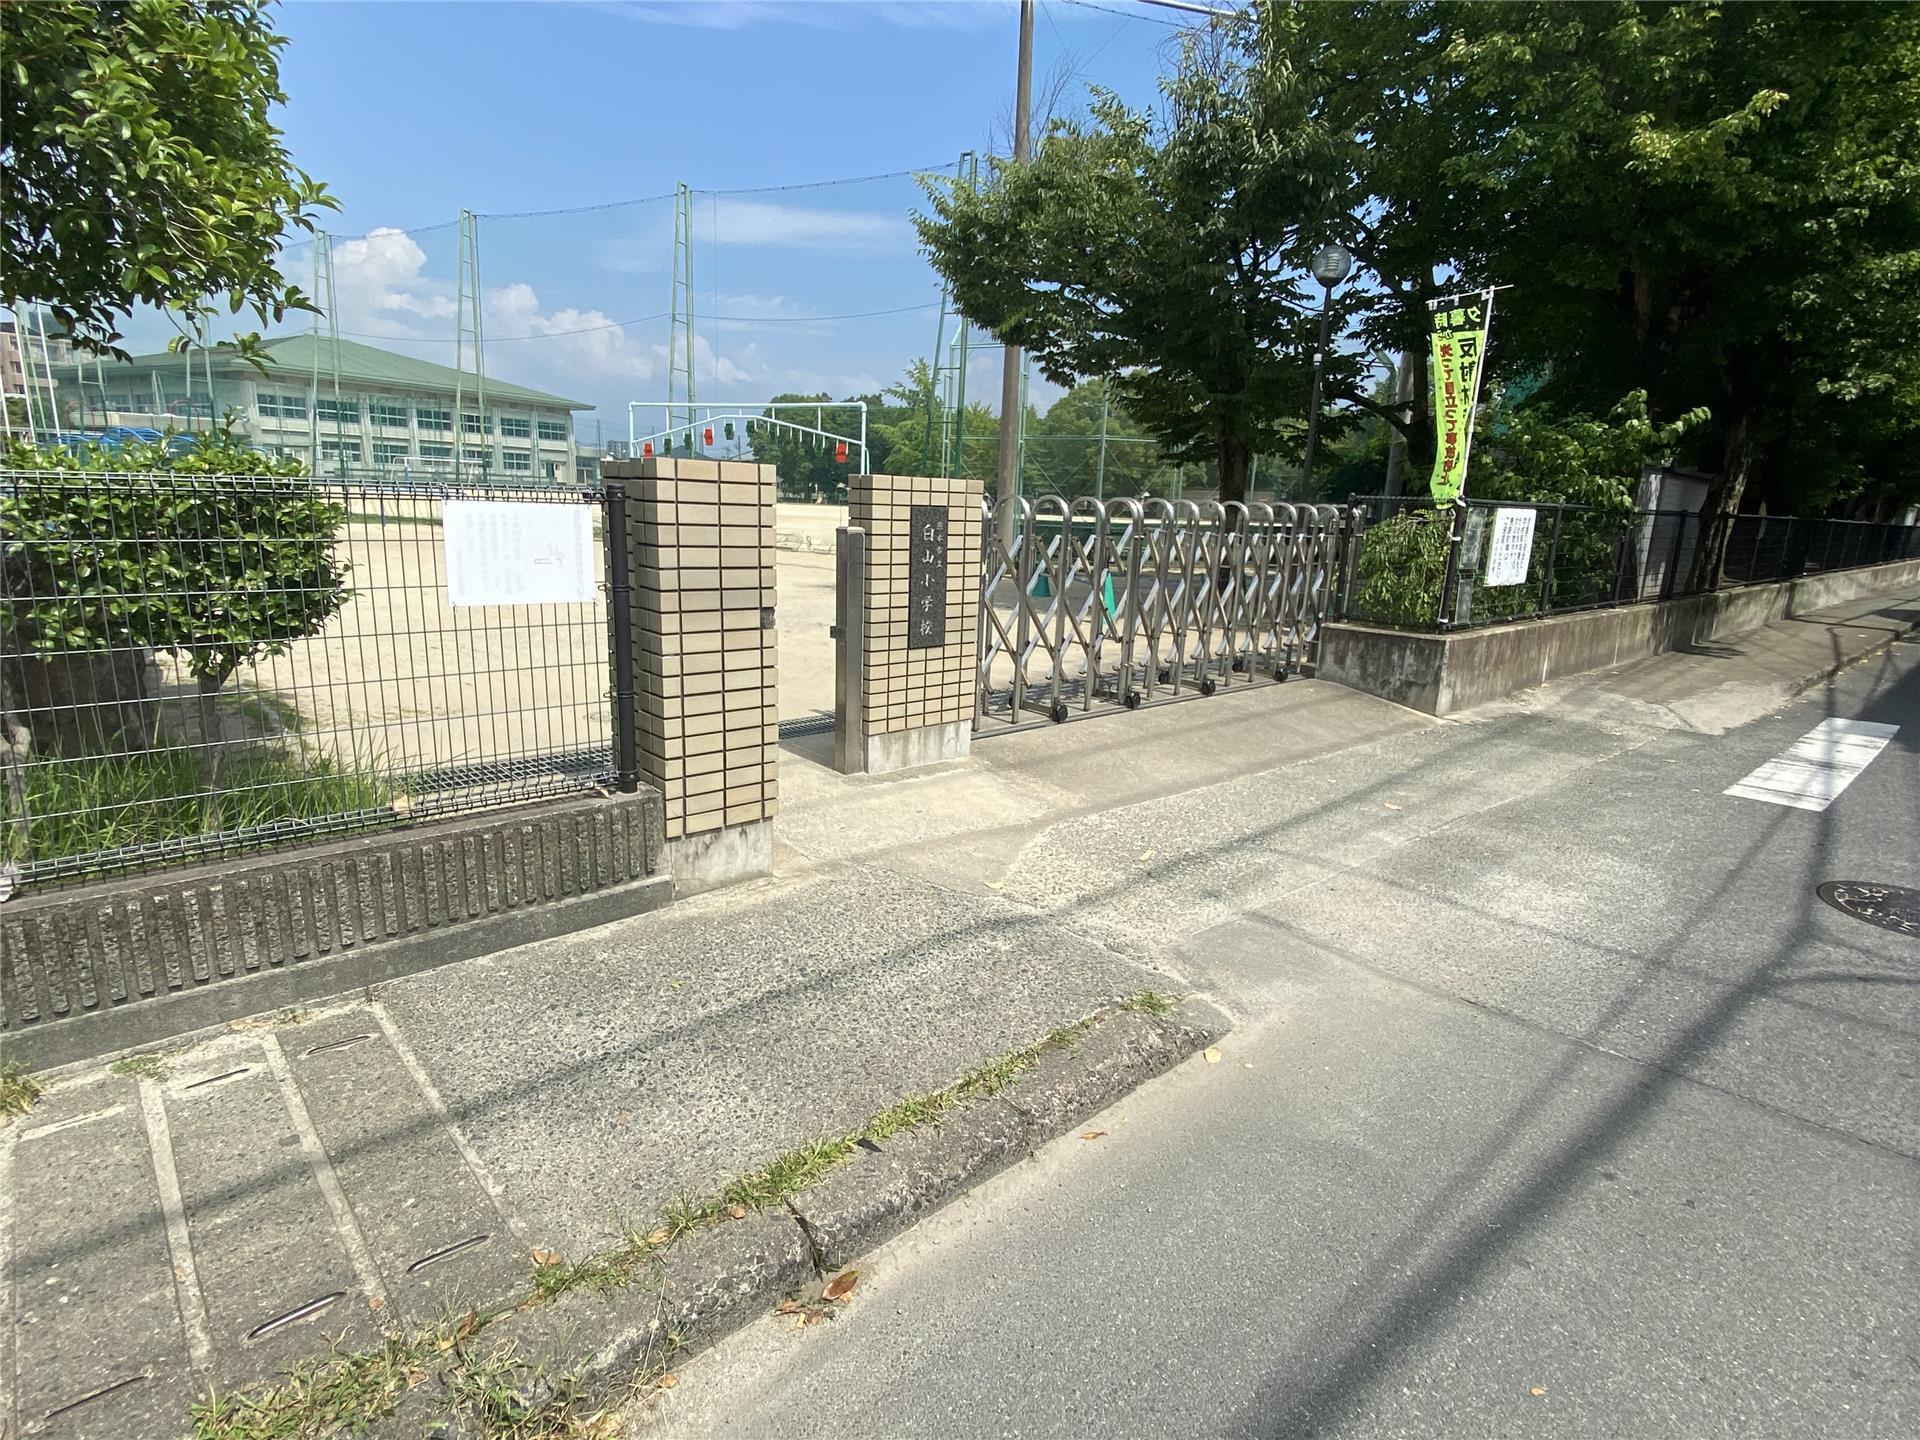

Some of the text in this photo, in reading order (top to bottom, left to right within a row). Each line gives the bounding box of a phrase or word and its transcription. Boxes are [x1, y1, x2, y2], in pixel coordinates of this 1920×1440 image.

[920, 524, 935, 636] 白山小学校
